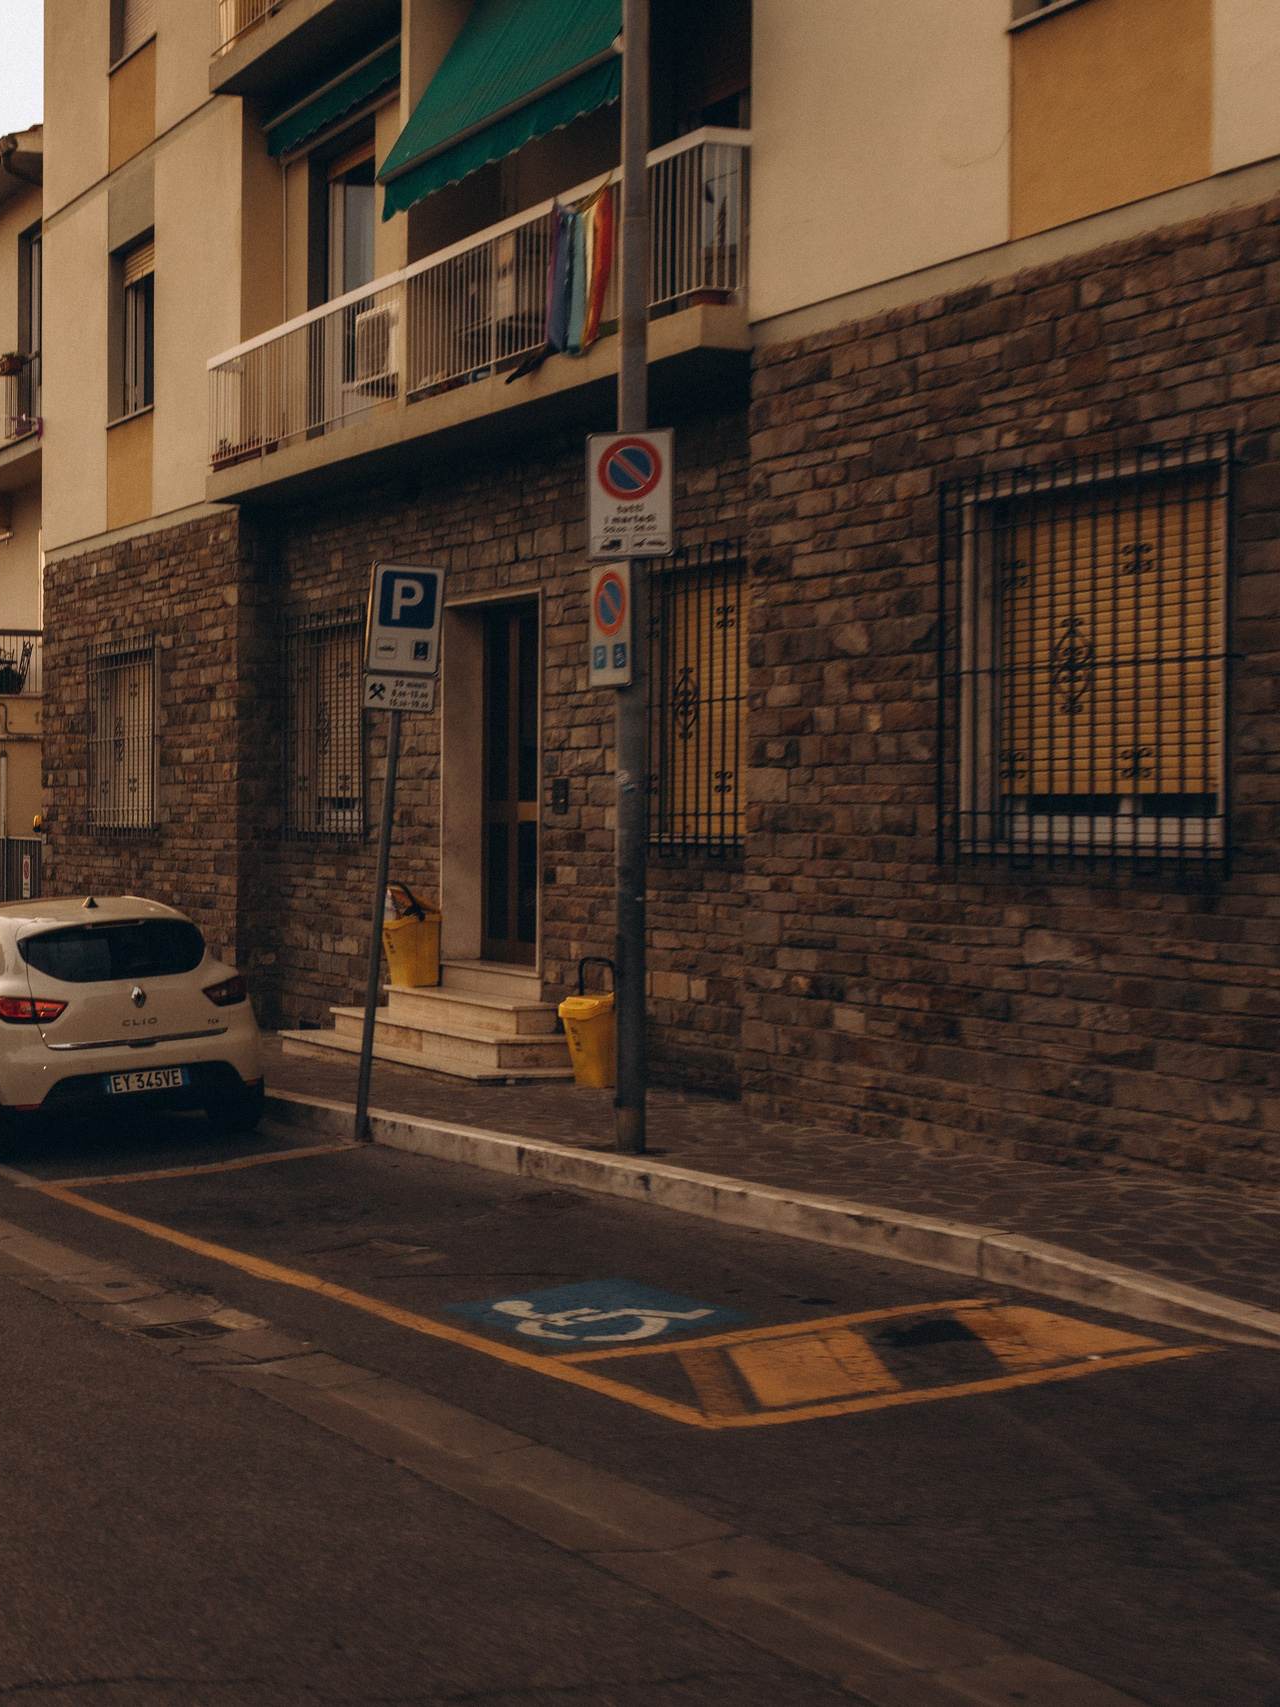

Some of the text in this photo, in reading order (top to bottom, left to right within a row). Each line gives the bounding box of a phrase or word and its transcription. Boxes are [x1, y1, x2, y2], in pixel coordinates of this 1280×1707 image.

[616, 503, 644, 514] tutti
[391, 578, 425, 621] P
[122, 1017, 158, 1027] CLIO
[113, 1069, 181, 1091] EY 345VE
